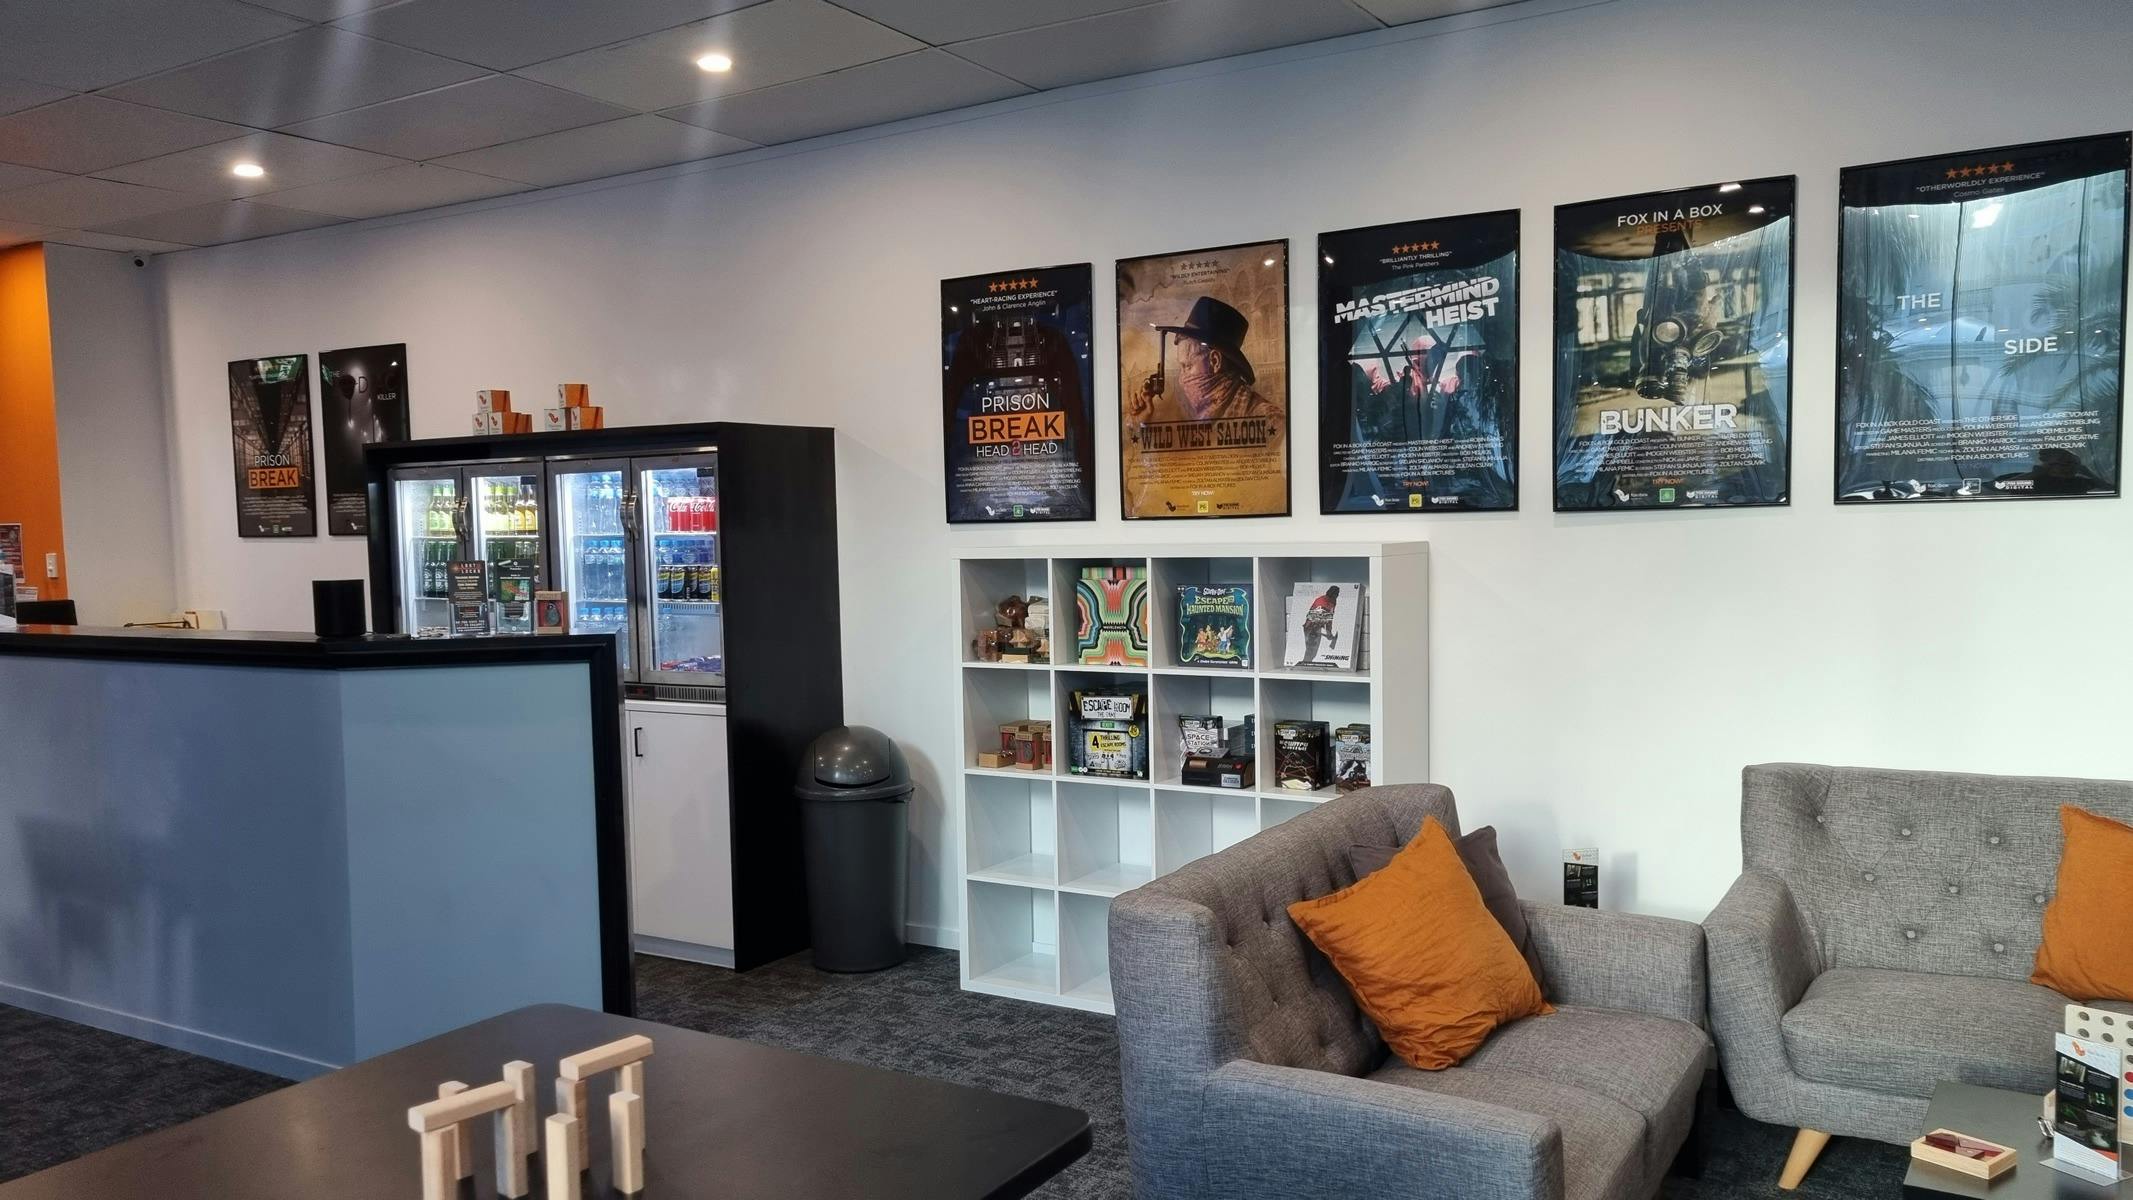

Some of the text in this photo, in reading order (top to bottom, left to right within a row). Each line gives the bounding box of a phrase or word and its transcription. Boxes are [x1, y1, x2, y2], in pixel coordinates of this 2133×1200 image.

[1916, 172, 2045, 192] "OTHERWORLDLY EXPERIENCE"
[1617, 204, 1723, 228] FOX IN A BOX
[1636, 219, 1703, 236] PRESENTS
[1334, 276, 1500, 324] MASTERMIND
[1897, 293, 1942, 310] THE
[1425, 297, 1499, 328] HEIST
[2004, 336, 2058, 354] SIDE
[982, 393, 1050, 412] PRISON
[972, 414, 1061, 441] BREAK
[1600, 404, 1738, 435] BUNKER
[1140, 420, 1266, 450] WILD WEST SALOON
[976, 440, 1058, 457] HEAD 2 HEAD
[254, 454, 290, 466] PRISON
[250, 470, 296, 486] BREAK
[1195, 596, 1229, 604] ESCAPE
[1187, 603, 1243, 616] HAUNTED MANSION
[1083, 699, 1130, 712] ESCAPE ROOM
[1092, 736, 1099, 748] 4
